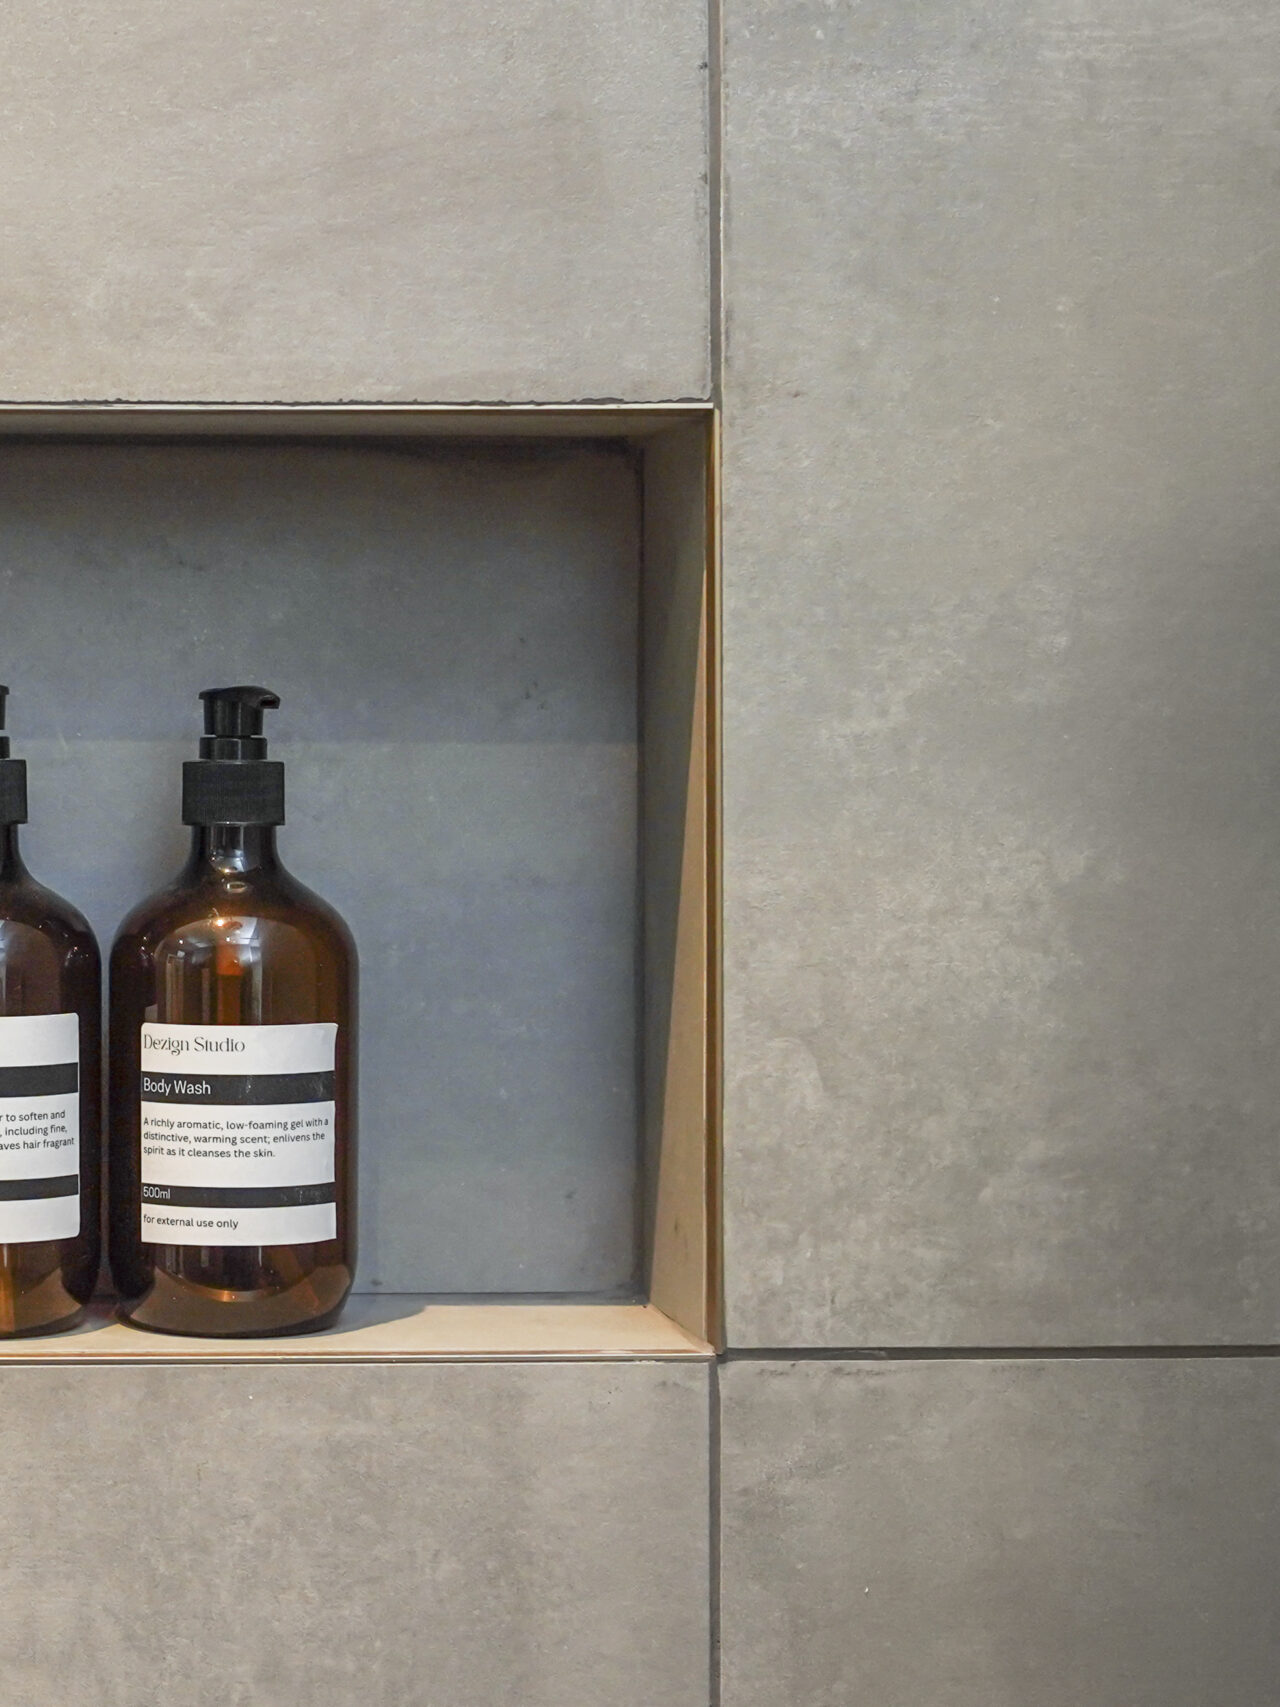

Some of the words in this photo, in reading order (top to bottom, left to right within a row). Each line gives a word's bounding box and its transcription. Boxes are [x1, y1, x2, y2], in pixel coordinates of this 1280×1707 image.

[144, 1035, 189, 1056] Dezign
[194, 1036, 245, 1053] Studio
[144, 1078, 171, 1095] Body
[174, 1080, 211, 1095] Wash
[19, 1112, 48, 1121] soften
[50, 1110, 65, 1119] and
[144, 1117, 149, 1125] A
[150, 1118, 174, 1129] richly
[177, 1120, 223, 1131] aromatic,
[226, 1120, 288, 1131] low-foaming
[291, 1119, 303, 1130] gel
[306, 1118, 323, 1128] with
[5, 1125, 48, 1136] including
[50, 1125, 67, 1133] fine,
[23, 1140, 41, 1149] hair
[43, 1137, 74, 1148] fragrant
[144, 1132, 192, 1144] distinctive,
[194, 1135, 237, 1145] warming
[240, 1136, 270, 1144] scent;
[273, 1134, 310, 1143] enlivens
[313, 1132, 325, 1140] the
[144, 1146, 164, 1155] spirit
[179, 1147, 185, 1156] it
[187, 1148, 231, 1158] cleanses
[253, 1149, 275, 1157] skin.
[144, 1187, 170, 1199] 500ml
[144, 1215, 154, 1223] for
[157, 1216, 194, 1227] external
[197, 1220, 213, 1228] use
[216, 1219, 238, 1230] only
